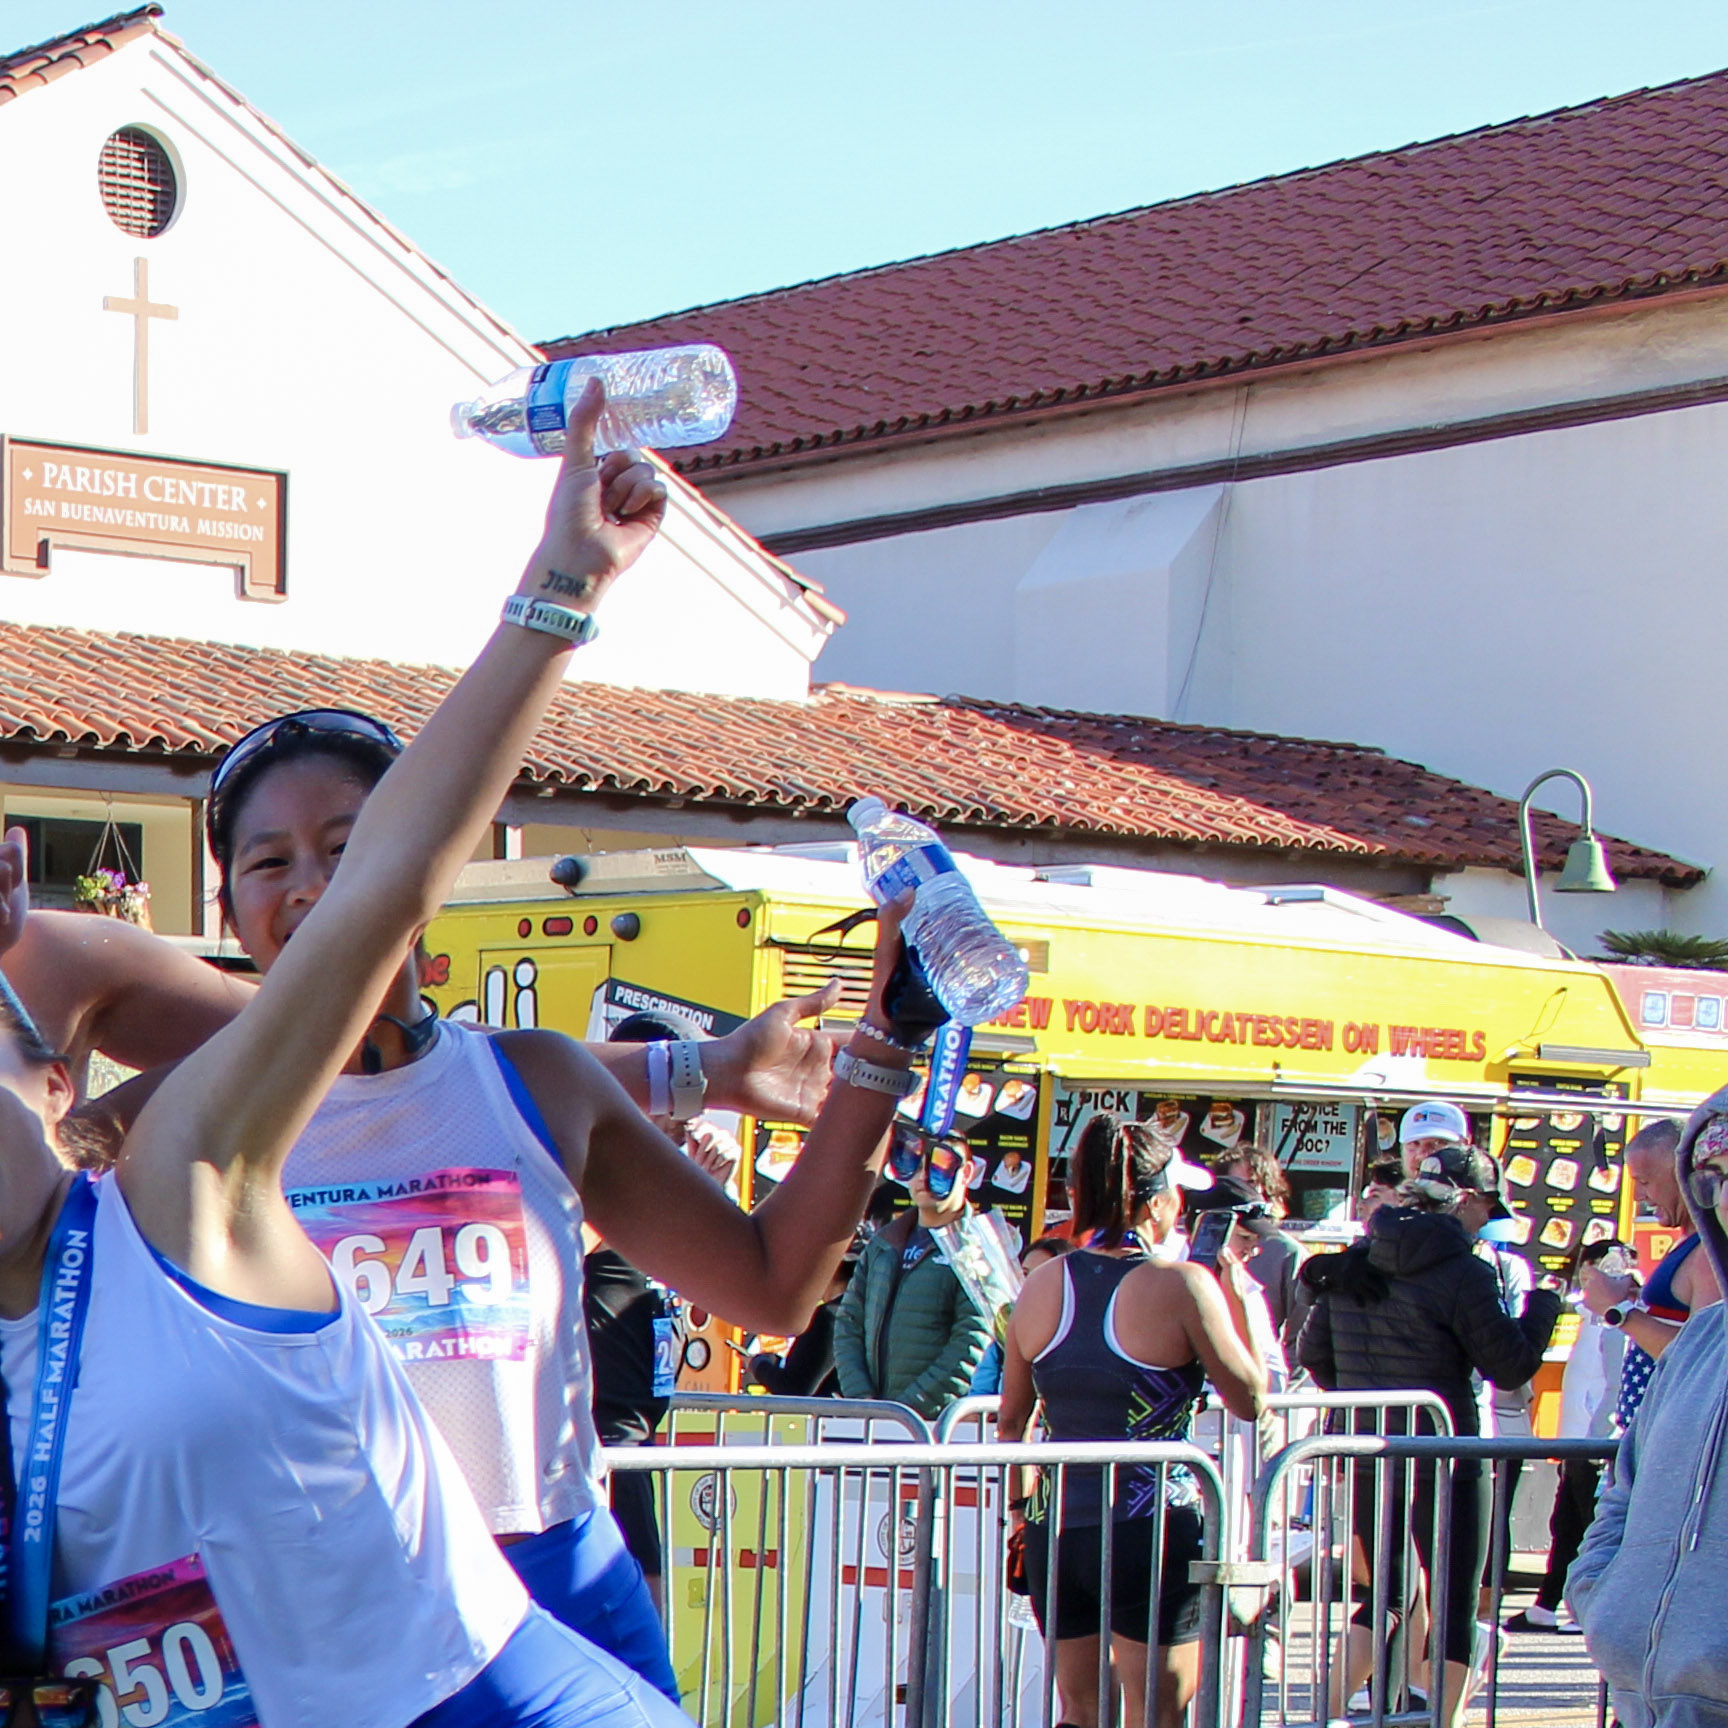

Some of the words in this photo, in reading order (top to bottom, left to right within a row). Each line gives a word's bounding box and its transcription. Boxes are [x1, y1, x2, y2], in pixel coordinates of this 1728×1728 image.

[42, 462, 137, 499] PARISH
[143, 475, 248, 512] CENTER
[24, 497, 56, 517] SAN
[60, 502, 190, 533] BUENAVENTURA
[196, 519, 264, 541] MISSION
[1062, 999, 1136, 1035] YORK
[1144, 1005, 1334, 1052] DELICATESSEN
[1343, 1021, 1379, 1054] ON
[1388, 1025, 1487, 1062] WHEELS
[1323, 1120, 1347, 1136] THE
[376, 1173, 492, 1199] MARATHON
[332, 1222, 513, 1316] 649
[47, 1229, 89, 1385] MARATHON
[385, 1327, 413, 1338] 2026
[391, 1337, 513, 1361] ARATHON
[33, 1387, 59, 1462] HALF
[24, 1476, 47, 1544] 2026
[78, 1567, 176, 1616] MARATHON
